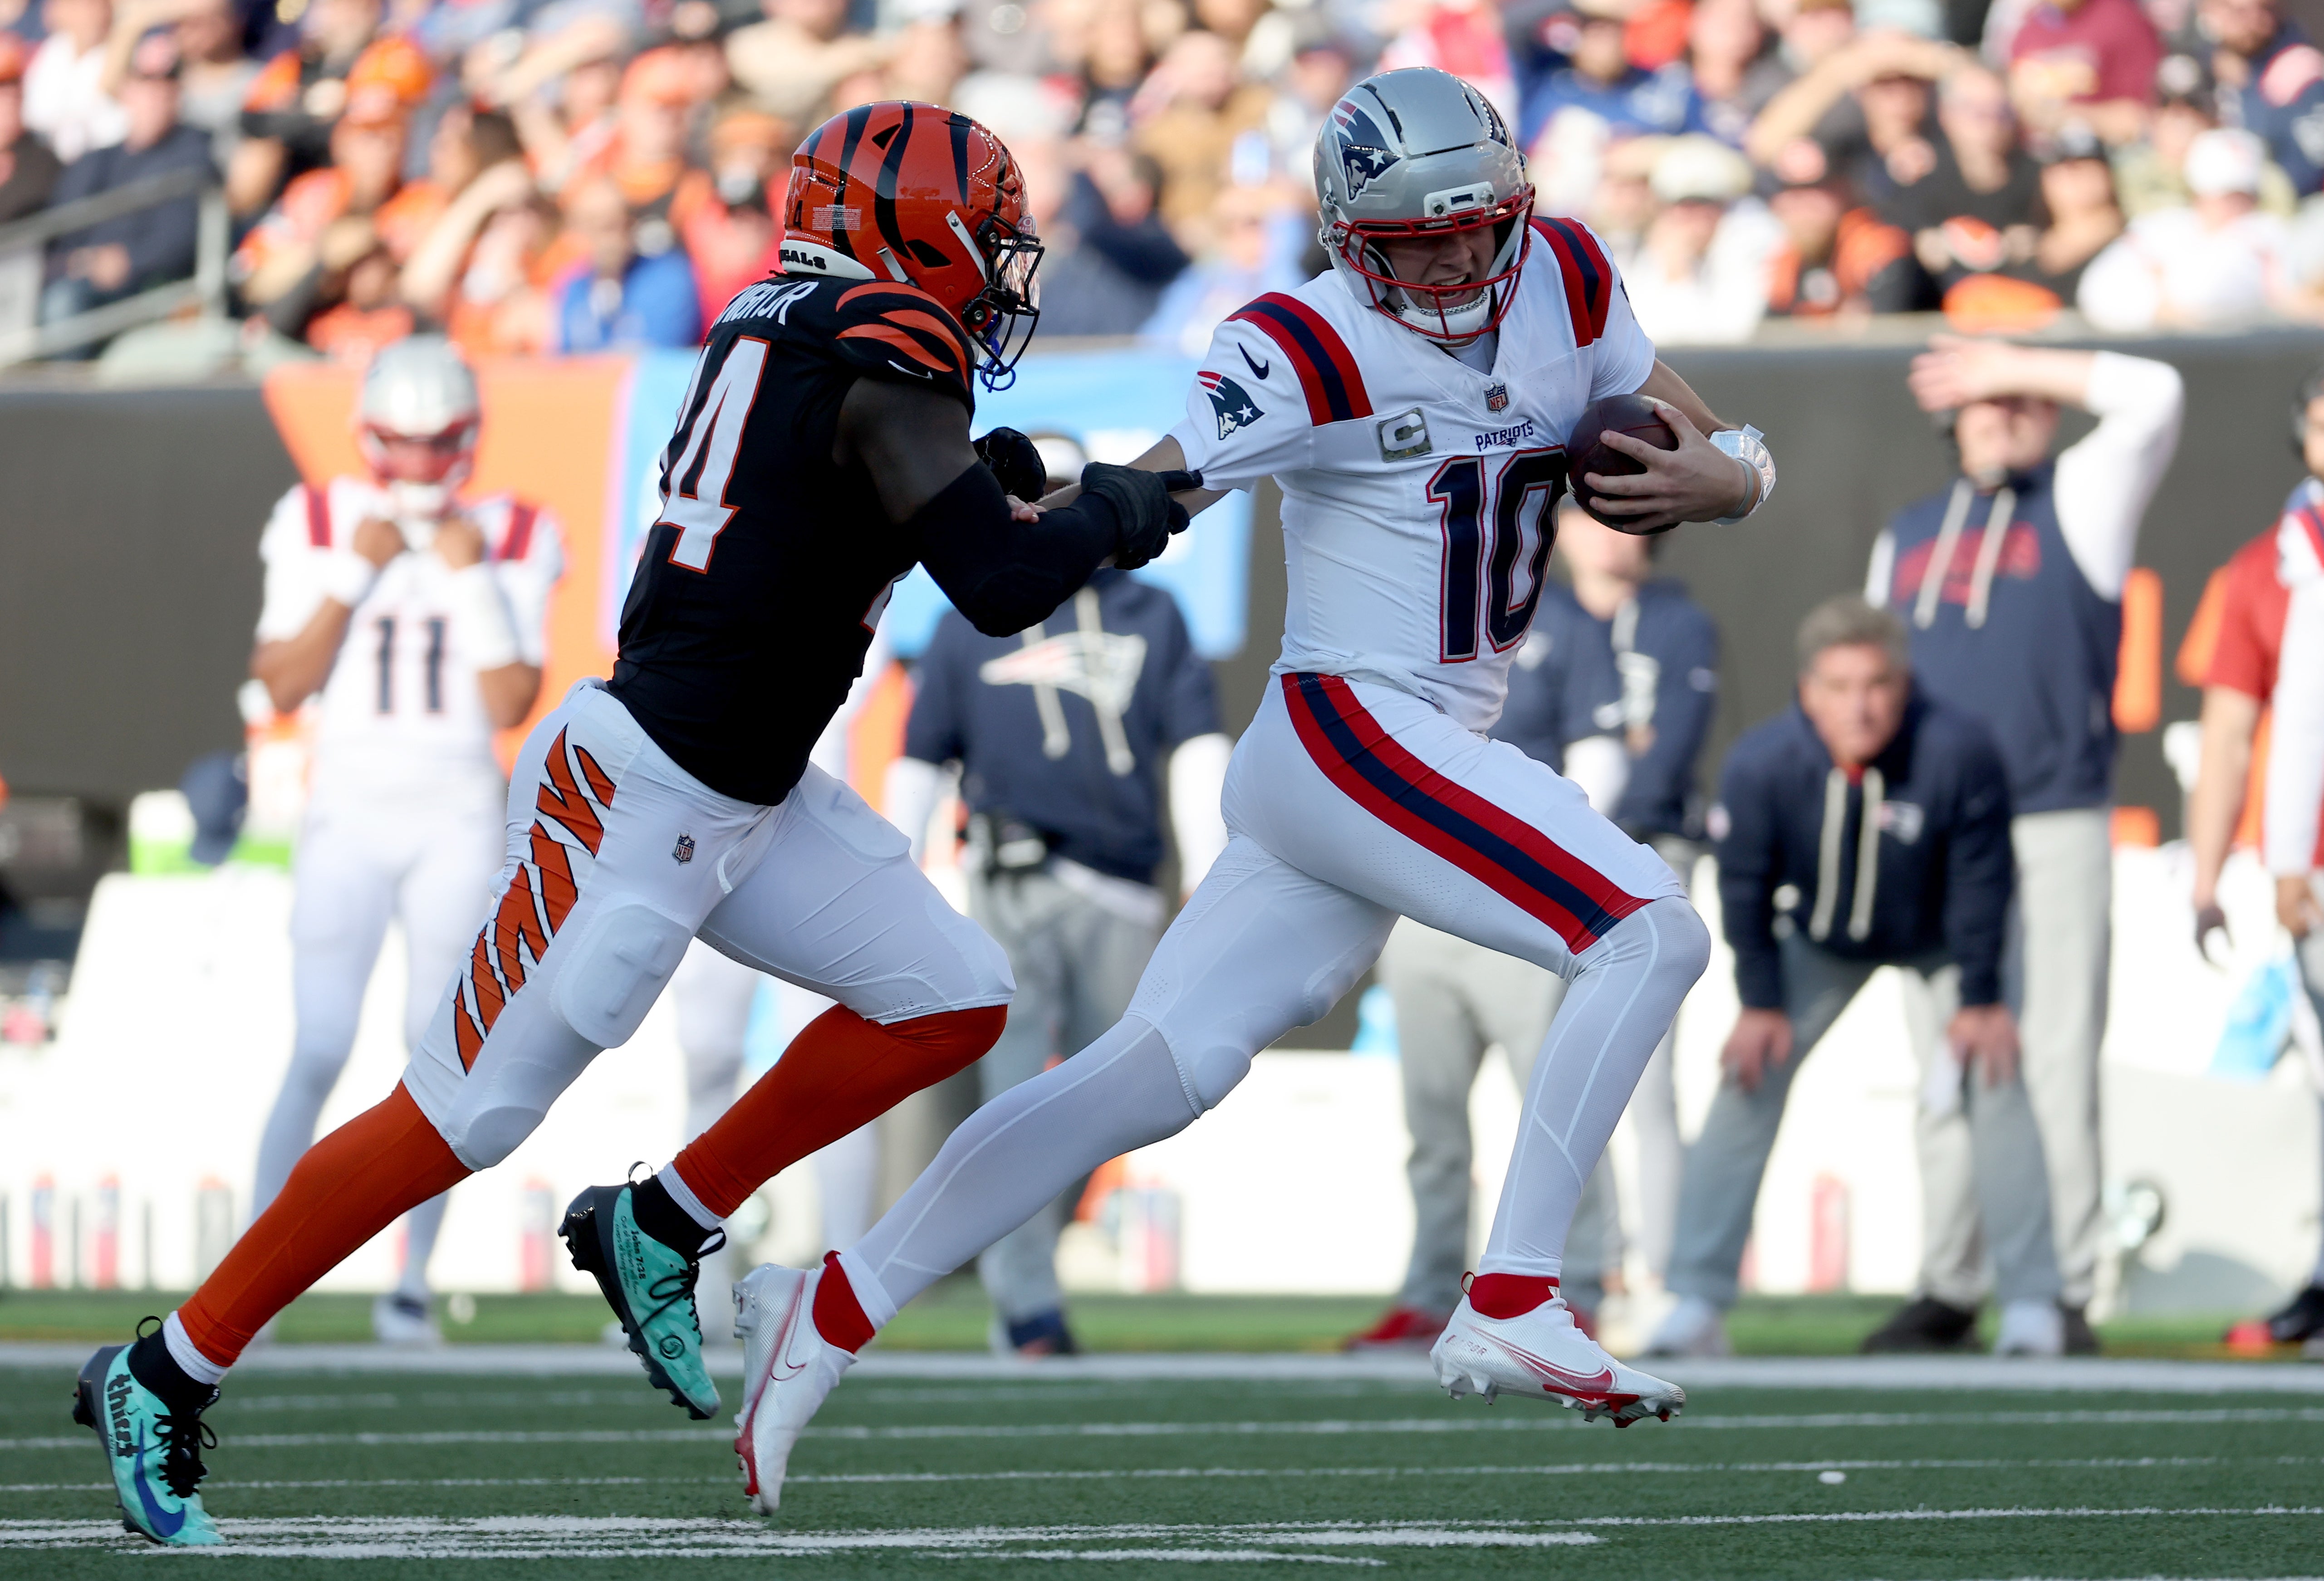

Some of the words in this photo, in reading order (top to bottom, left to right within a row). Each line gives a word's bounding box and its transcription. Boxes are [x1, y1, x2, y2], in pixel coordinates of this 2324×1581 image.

[1490, 395, 1506, 409] NFL
[1382, 413, 1425, 451] C
[1475, 420, 1534, 452] PATRIOTS
[1426, 444, 1568, 664] 10
[373, 615, 448, 714] 11
[675, 845, 691, 860] NFL
